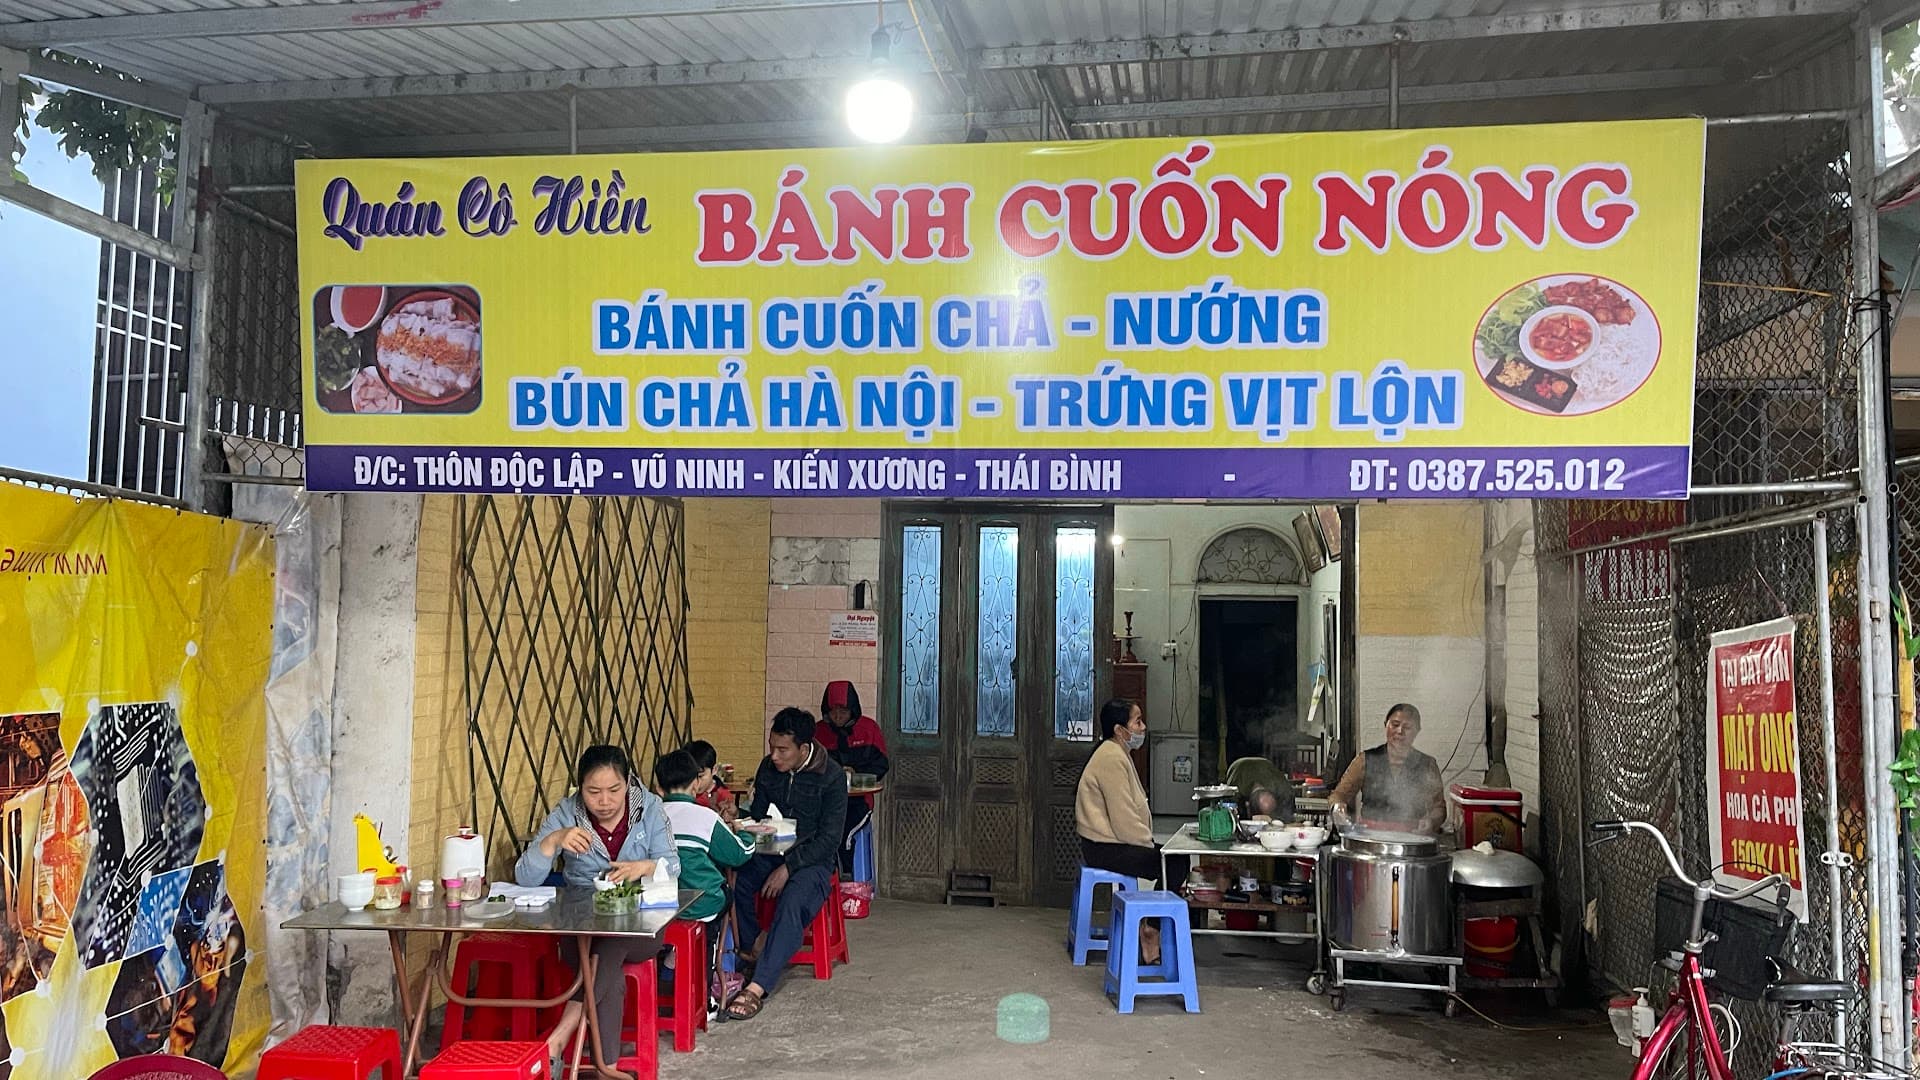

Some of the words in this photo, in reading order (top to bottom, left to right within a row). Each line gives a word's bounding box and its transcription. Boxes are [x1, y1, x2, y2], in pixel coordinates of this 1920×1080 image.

[323, 177, 446, 251] Quán
[457, 176, 518, 235] Cô
[532, 170, 652, 235] Hiền
[696, 168, 974, 262] BÁNH
[999, 144, 1290, 257] CUỐN
[1315, 148, 1635, 251] NÓNG
[597, 294, 746, 350] BÁNH
[765, 284, 917, 349] CUỐN
[937, 279, 1052, 348] CHẢ
[1112, 281, 1321, 346] NƯỚNG
[515, 372, 623, 427] BÚN
[642, 361, 751, 428] CHẢ
[768, 371, 842, 427] HÀ
[859, 370, 955, 438] NỘI
[1014, 365, 1208, 427] TRỨNG
[1228, 377, 1319, 437] VỊT
[1338, 366, 1457, 436] LỘN
[353, 455, 406, 486] Đ/C:
[413, 450, 483, 487] THÔN
[490, 450, 545, 494] ĐỘC
[552, 451, 604, 495] LẬP
[631, 452, 667, 489] VŨ
[675, 459, 745, 490] NINH
[772, 448, 839, 490] KIẾN
[847, 456, 946, 491] XƯƠNG
[975, 452, 1040, 491] THÁI
[1049, 452, 1122, 492] BÌNH
[1349, 458, 1398, 492] ĐT:
[1407, 457, 1627, 492] 0387.525.012
[1721, 657, 1738, 694] TẠI
[1722, 702, 1755, 784] MẬT
[1726, 791, 1750, 821] HOA
[1751, 789, 1772, 824] CÀ
[1778, 839, 1800, 880] LÍ
